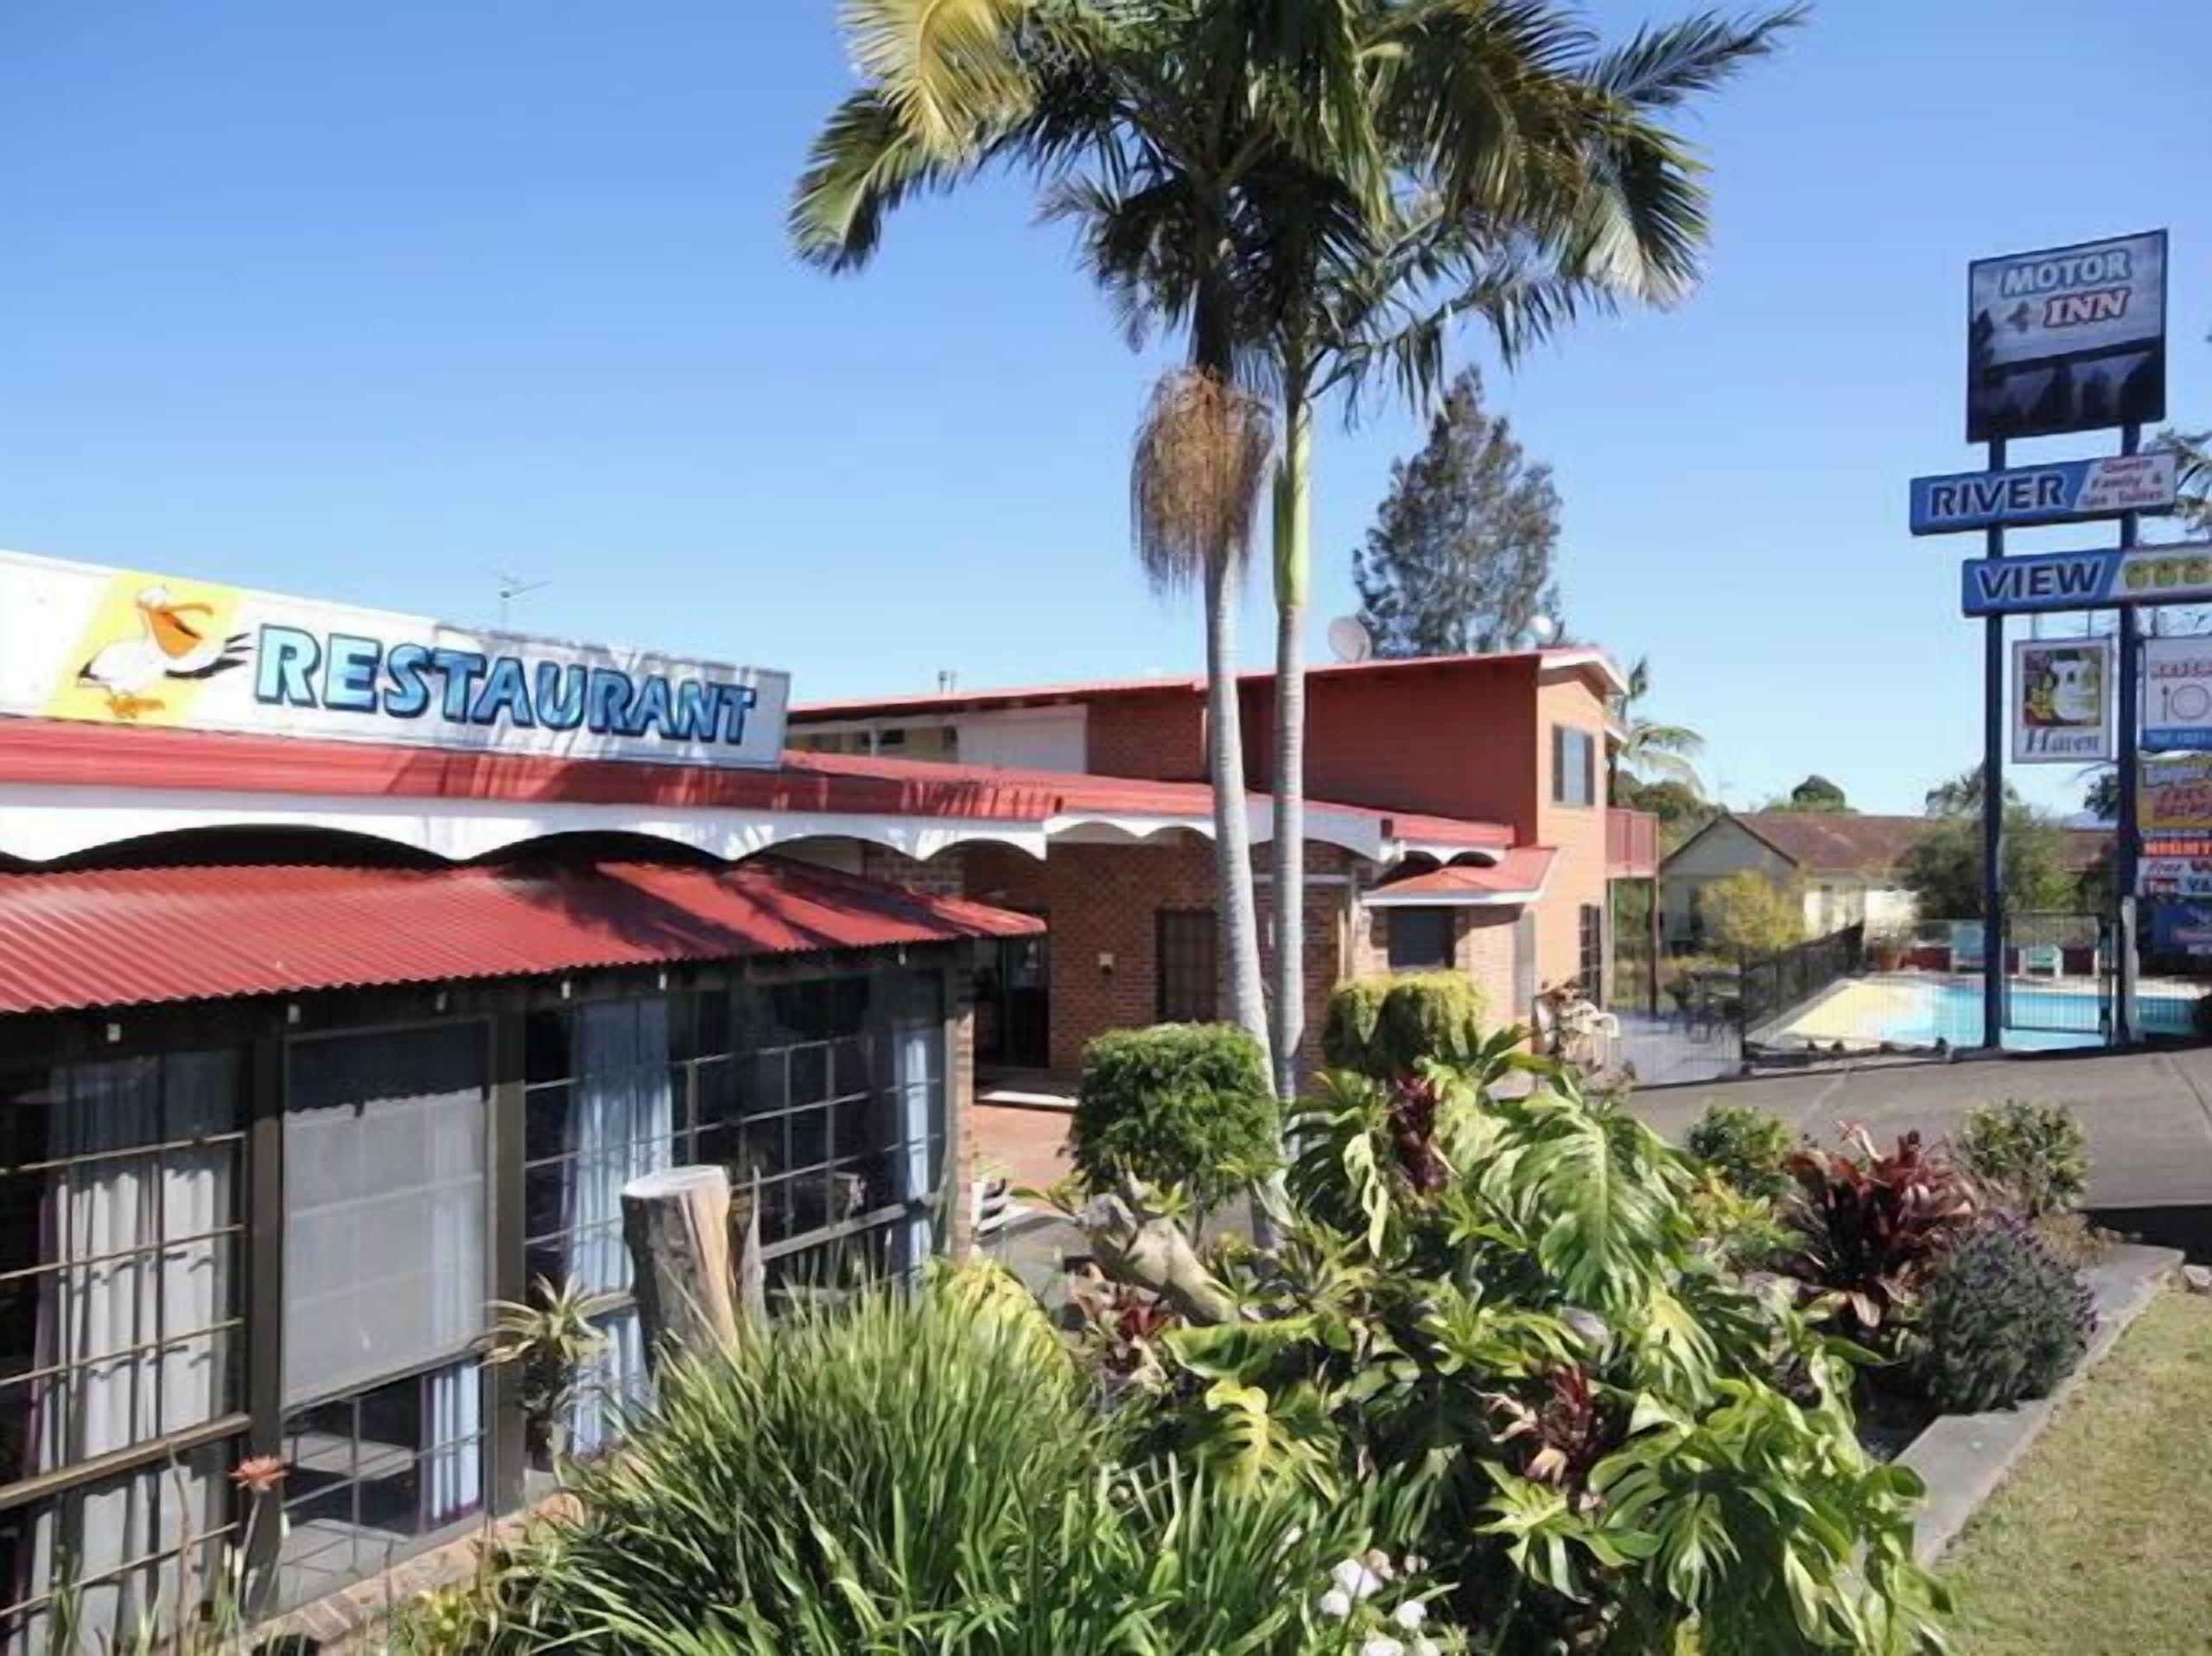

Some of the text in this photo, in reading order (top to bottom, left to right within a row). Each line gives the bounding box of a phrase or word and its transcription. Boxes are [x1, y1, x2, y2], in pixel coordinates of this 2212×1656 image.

[2002, 251, 2130, 296] MOTOR
[2044, 289, 2131, 327] INN
[1929, 473, 2065, 518] RIVER
[1977, 560, 2102, 600] VIEW
[257, 623, 757, 745] RESTAURANT
